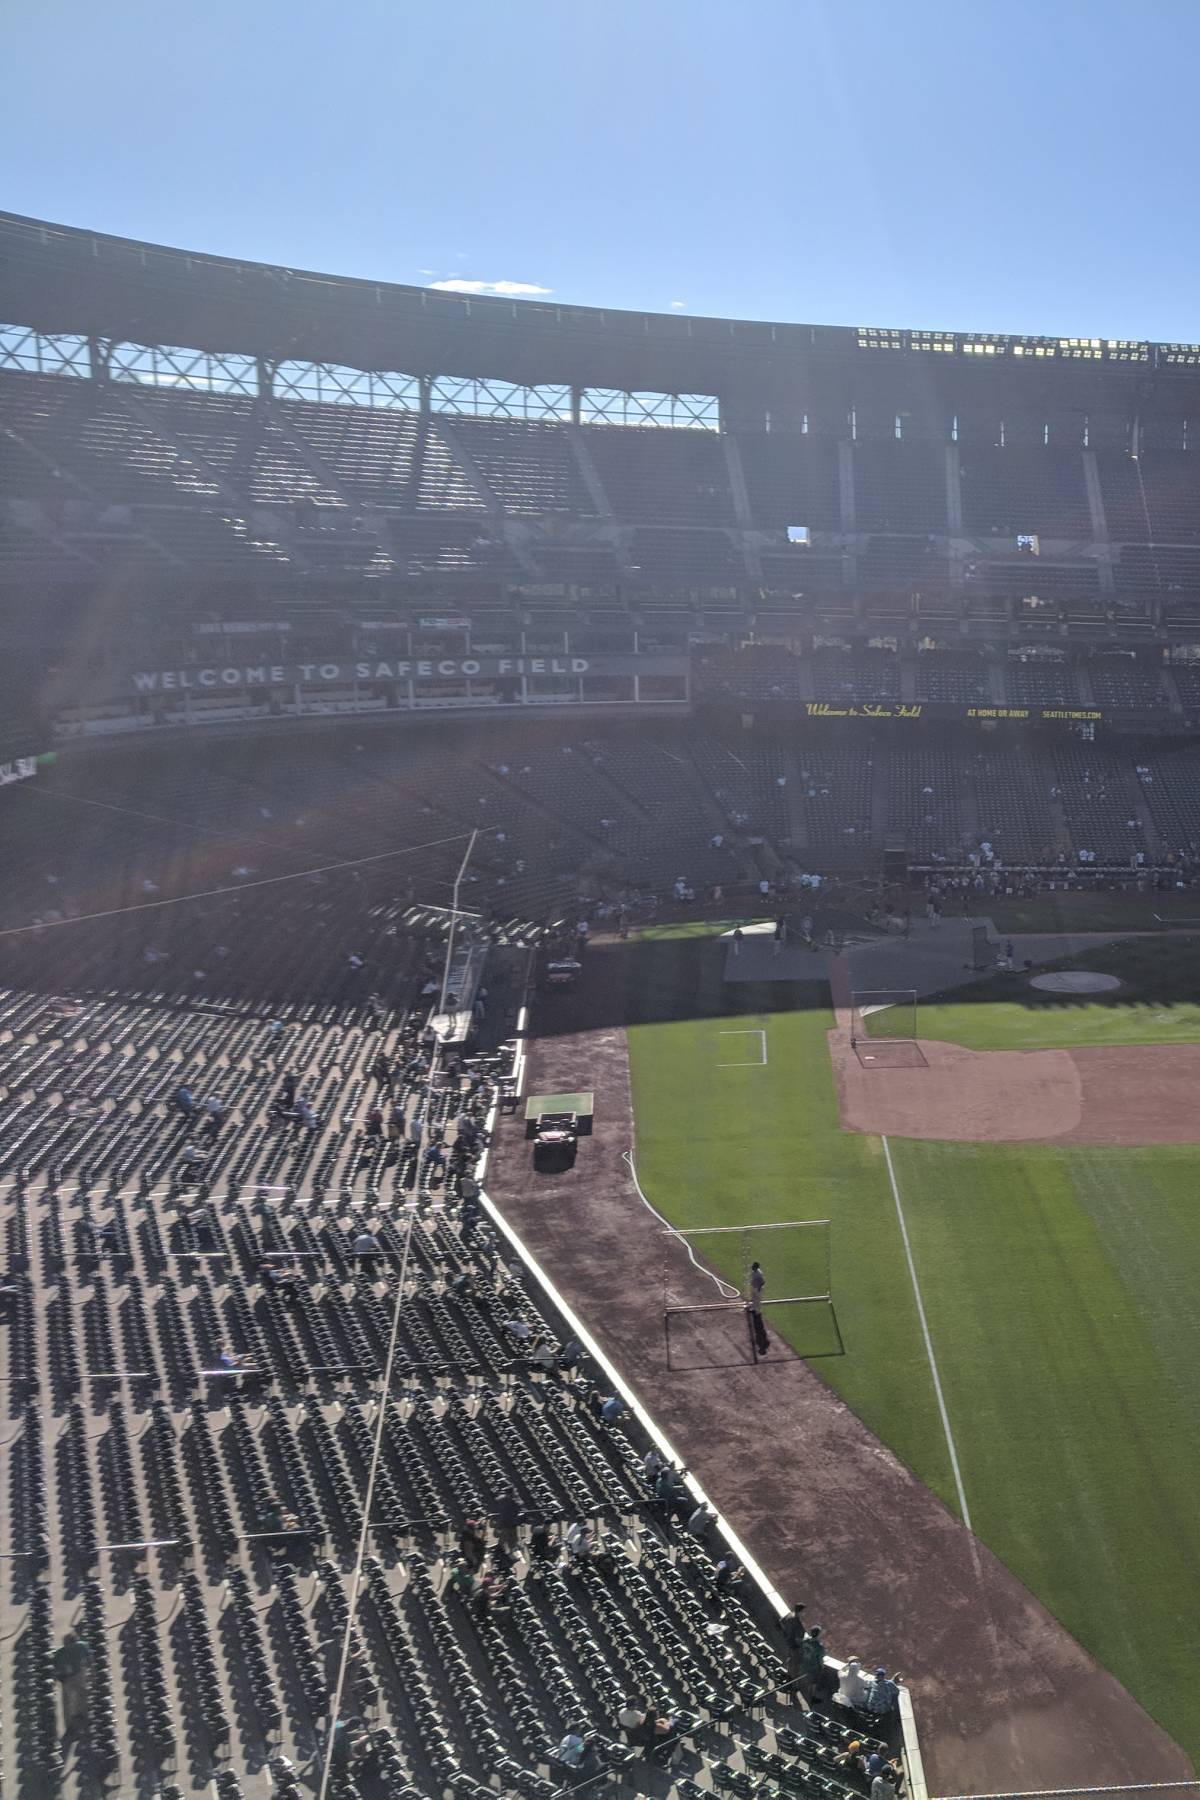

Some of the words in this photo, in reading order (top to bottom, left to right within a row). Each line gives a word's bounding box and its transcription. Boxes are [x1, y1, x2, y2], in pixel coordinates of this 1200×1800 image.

[132, 665, 285, 689] WELCOME
[299, 663, 339, 680] TO
[355, 660, 480, 678] SAFECO
[499, 658, 589, 674] FIELD
[806, 703, 848, 717] Welcome
[894, 703, 922, 718] Field
[967, 709, 977, 718] AT
[977, 709, 996, 719] HOME
[998, 710, 1009, 719] OR
[1009, 710, 1029, 719] AWAY
